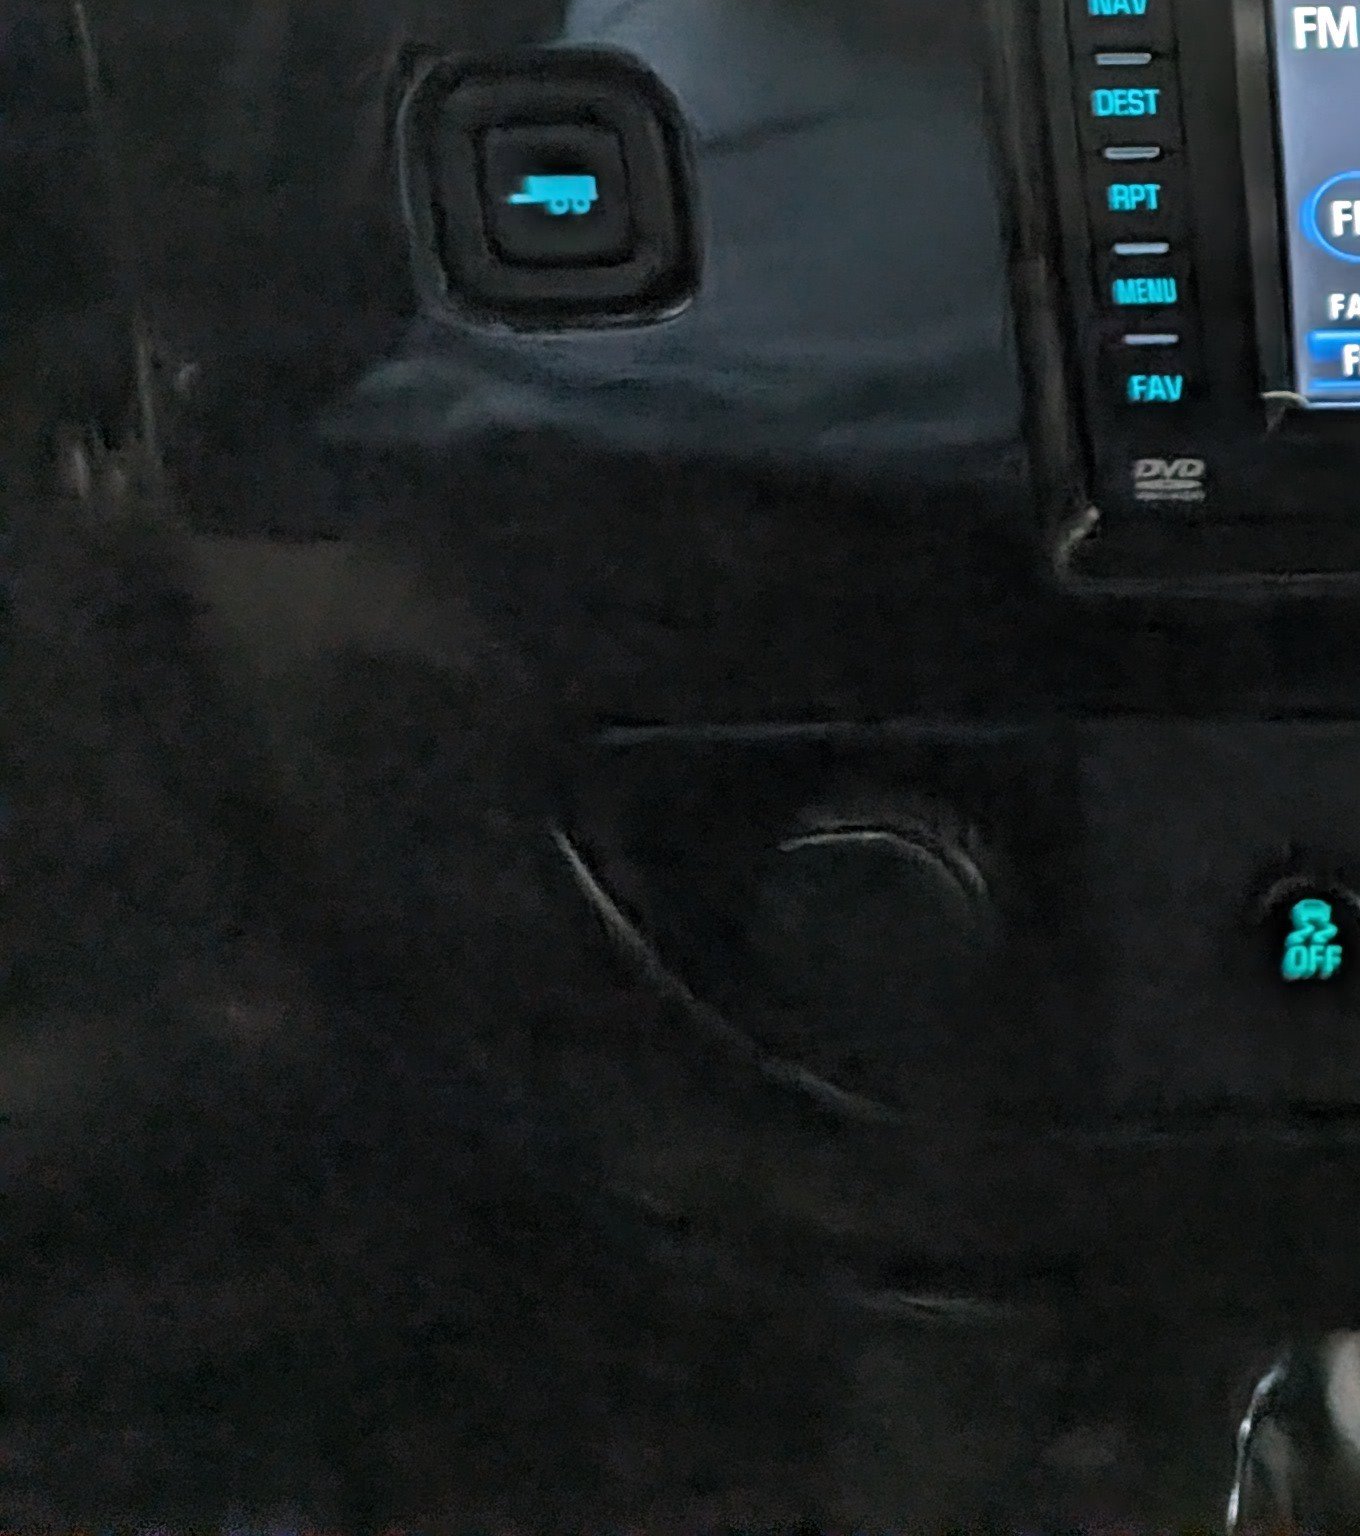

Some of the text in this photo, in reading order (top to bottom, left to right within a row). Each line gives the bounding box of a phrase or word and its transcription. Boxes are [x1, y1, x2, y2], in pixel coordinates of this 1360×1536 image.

[1292, 6, 1359, 50] FM
[1092, 88, 1160, 118] DEST
[1108, 184, 1160, 211] RPT
[1113, 277, 1177, 305] MENU
[1127, 374, 1183, 402] FAV
[1134, 459, 1204, 480] DVD
[1282, 945, 1342, 981] OFF
